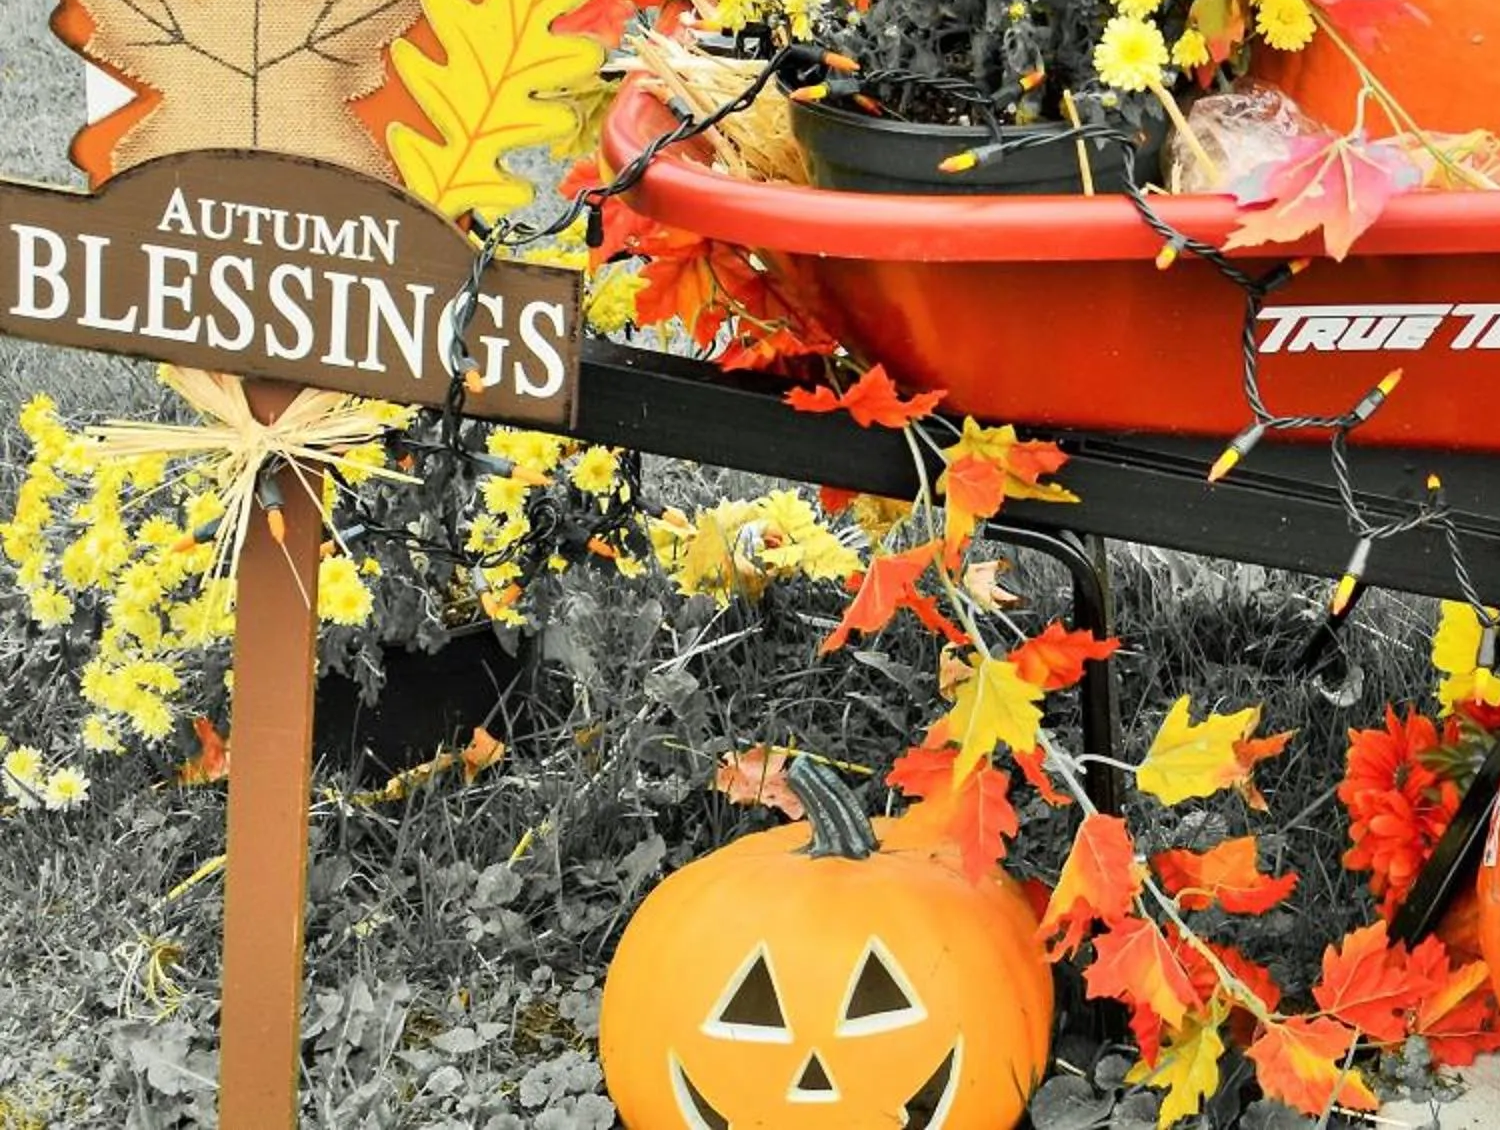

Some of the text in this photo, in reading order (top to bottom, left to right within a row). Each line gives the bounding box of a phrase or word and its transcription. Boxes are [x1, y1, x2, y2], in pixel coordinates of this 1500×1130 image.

[157, 187, 400, 265] AUTUMN
[9, 223, 566, 398] BLESSINGS
[1257, 304, 1454, 352] TRUE
